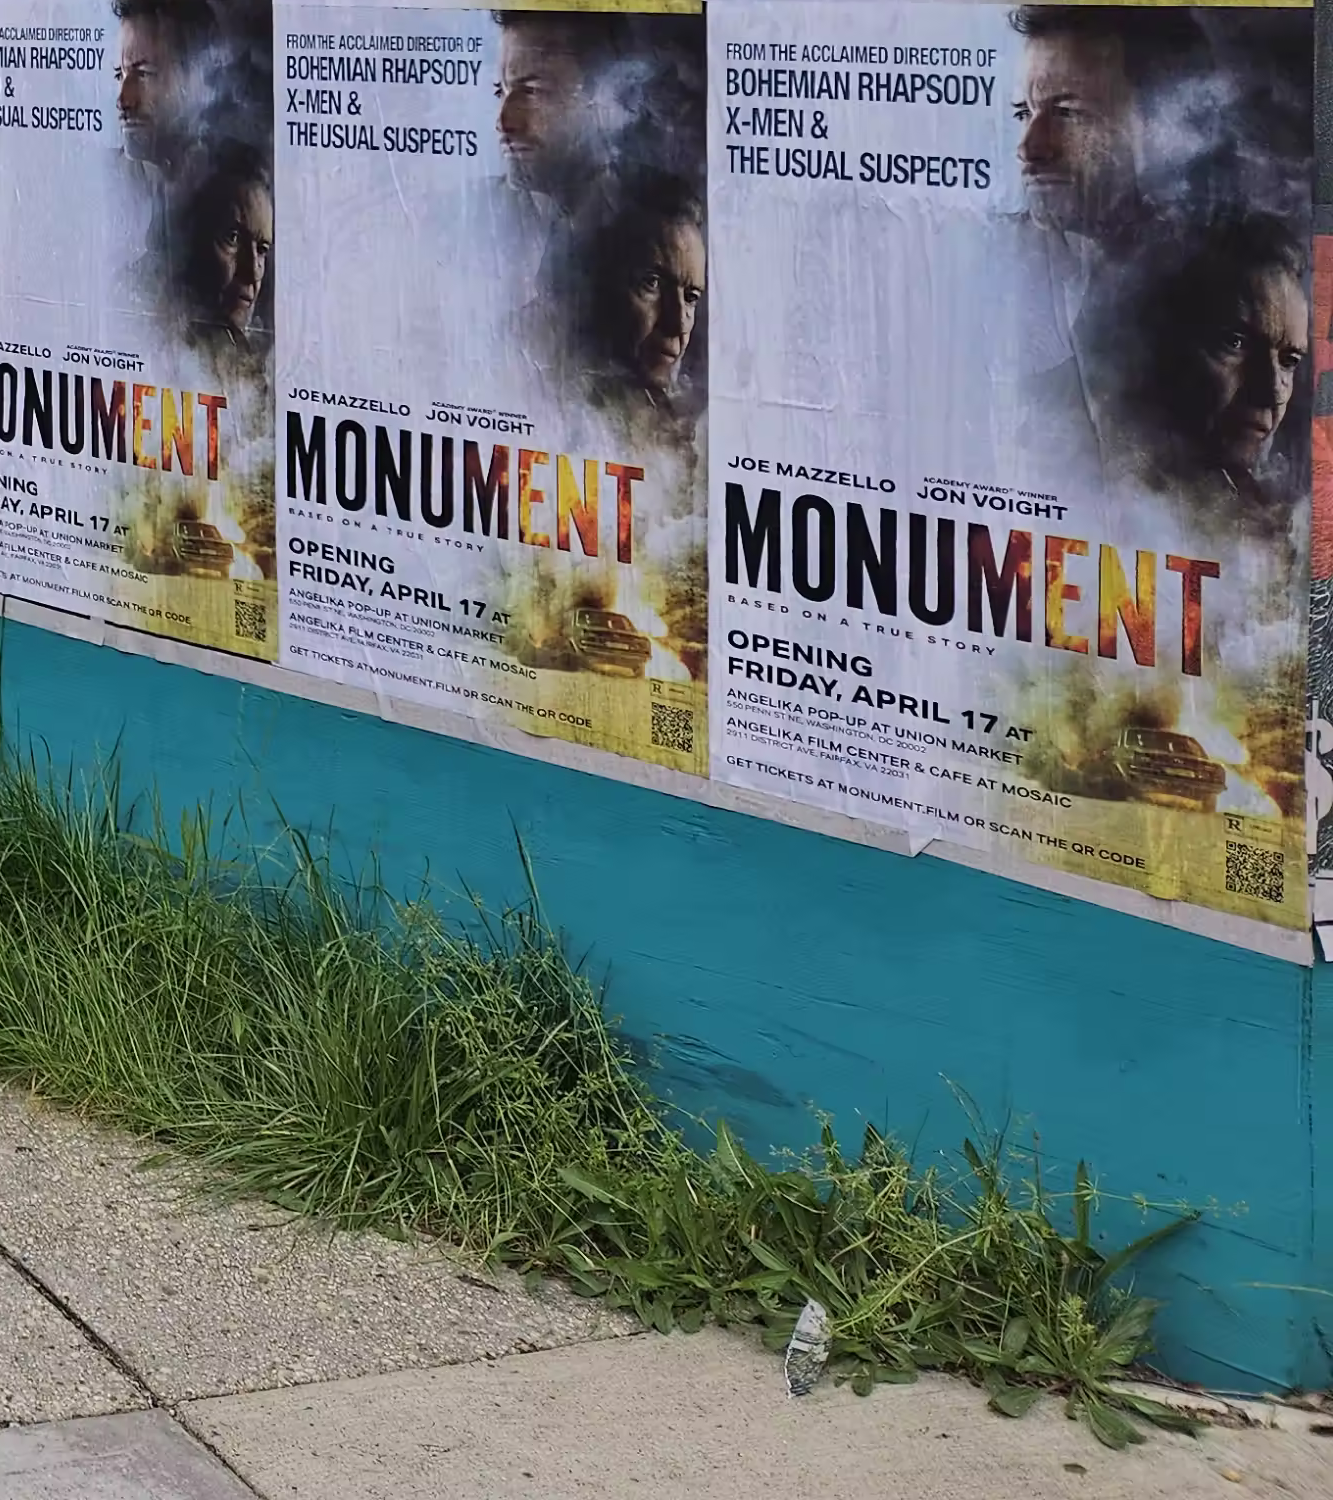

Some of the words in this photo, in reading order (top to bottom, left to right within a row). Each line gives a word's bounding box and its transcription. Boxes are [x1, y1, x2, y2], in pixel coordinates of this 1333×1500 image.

[29, 46, 104, 70] RHAPSODY
[286, 55, 376, 82] BOHEMIAN
[381, 57, 480, 86] RHAPSODY
[726, 43, 765, 61] FROM
[768, 43, 797, 62] THE
[801, 44, 888, 64] ACCLAIMED
[893, 46, 971, 67] DIRECTOR
[976, 48, 997, 67] OF
[4, 75, 14, 97] &
[286, 88, 343, 115] X-MEN
[347, 90, 361, 115] &
[726, 68, 850, 100] BOHEMIAN
[857, 72, 995, 106] RHAPSODY
[30, 106, 102, 132] SUSPECTS
[286, 121, 318, 148] THE
[322, 123, 379, 151] USUAL
[382, 126, 478, 157] SUSPECTS
[726, 106, 803, 138] X-MEN
[810, 109, 828, 139] &
[726, 144, 769, 176] THE
[775, 147, 853, 181] USUAL
[859, 151, 991, 190] SUSPECTS
[285, 410, 643, 567] MONUMENT
[727, 454, 769, 475] JOE
[775, 462, 896, 495] MAZZELLO
[916, 483, 970, 506] JON
[974, 492, 1067, 522] VOIGHT
[29, 500, 84, 528] APRIL
[89, 513, 110, 533] 17
[288, 535, 394, 575] OPENING
[288, 560, 373, 597] FRIDAY,
[379, 579, 451, 612] APRIL
[458, 596, 486, 620] 17
[724, 481, 1220, 681] MONUMENT
[727, 594, 789, 615] BASED
[801, 609, 827, 623] ON
[861, 620, 913, 640] TRUE
[927, 633, 995, 656] STORY
[727, 627, 872, 678] OPENING
[727, 655, 842, 703] FRIDAY,
[851, 682, 950, 725] APRIL
[960, 706, 997, 736] 17
[1005, 723, 1034, 744] AT
[727, 687, 804, 716] ANGELIKA
[808, 705, 867, 731] POP-UP
[894, 725, 947, 749] UNION
[951, 738, 1023, 767] MARKET
[726, 754, 753, 772] GET
[756, 761, 814, 787] TICKETS
[837, 782, 959, 824] MONUMENT.FILM
[989, 819, 1033, 842] SCAN
[1036, 831, 1068, 851] THE
[1070, 839, 1094, 858] QR
[1098, 846, 1145, 870] CODE
